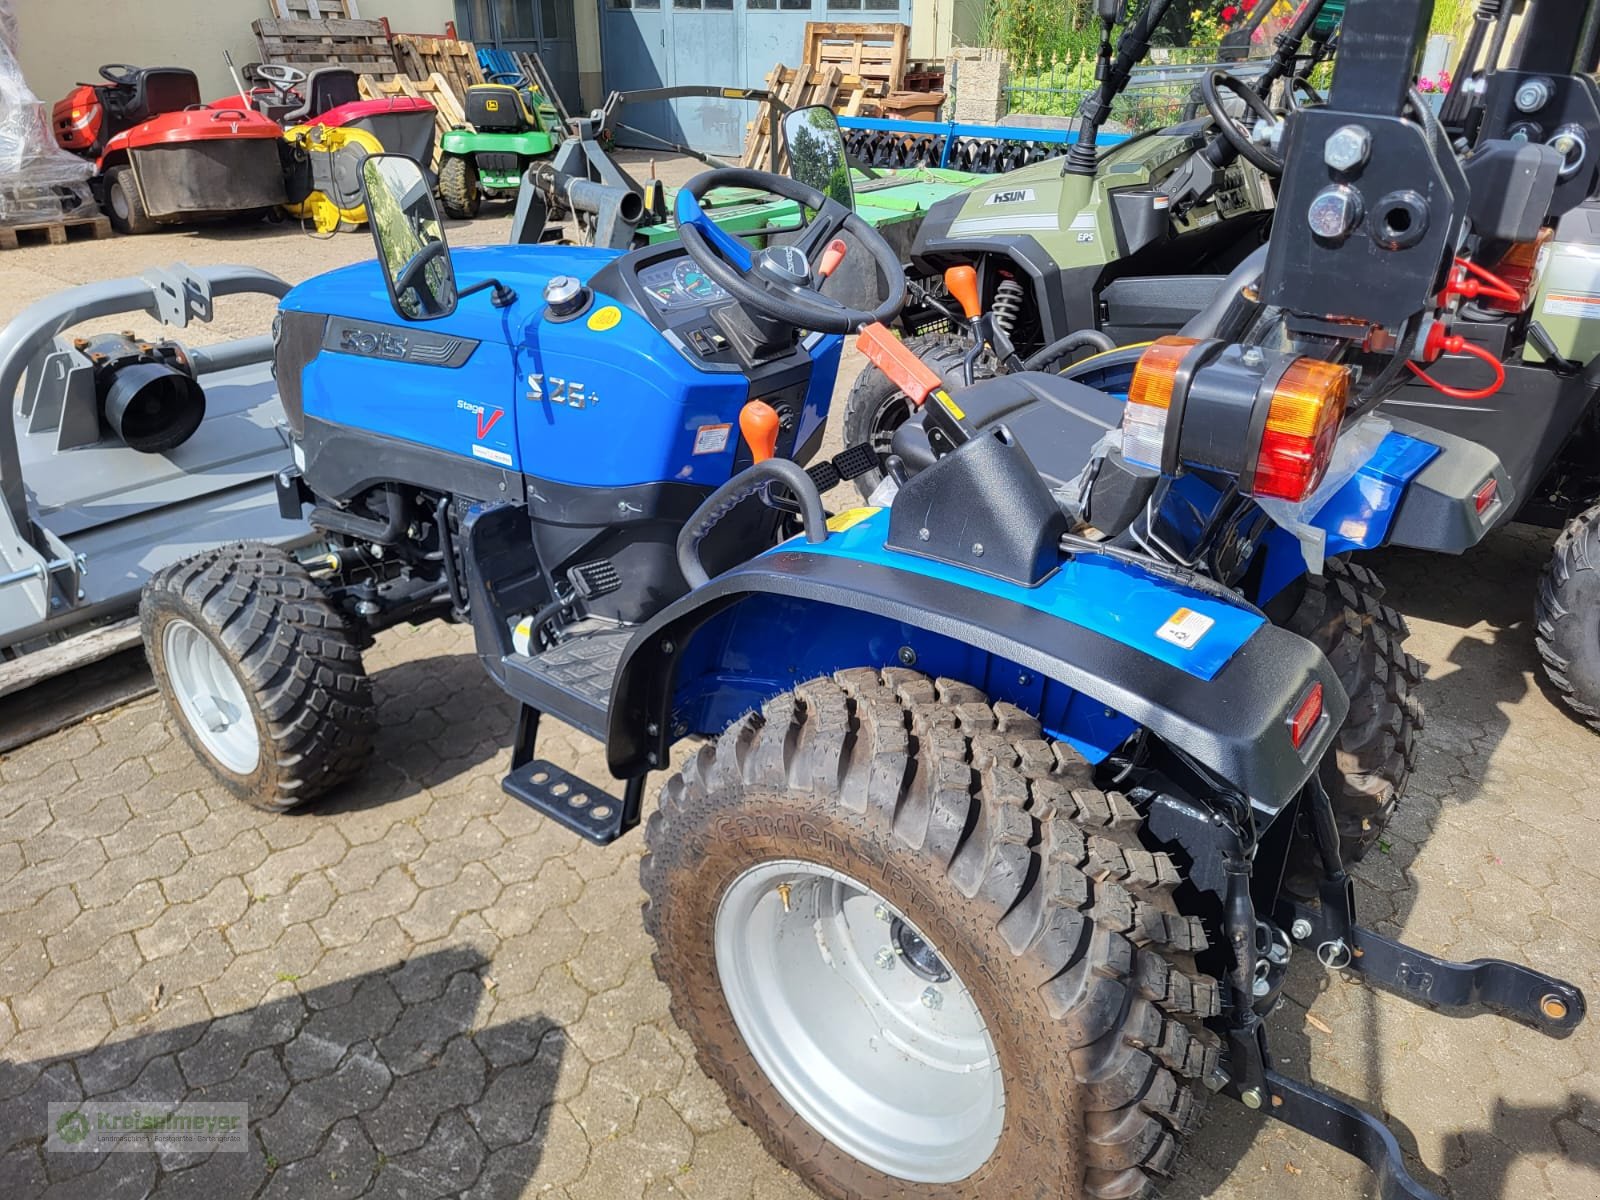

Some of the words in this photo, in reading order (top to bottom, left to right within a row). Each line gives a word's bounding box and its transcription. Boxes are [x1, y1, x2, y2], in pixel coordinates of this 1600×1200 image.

[1077, 232, 1094, 242] EPS
[456, 399, 485, 415] Stage
[477, 409, 504, 439] V
